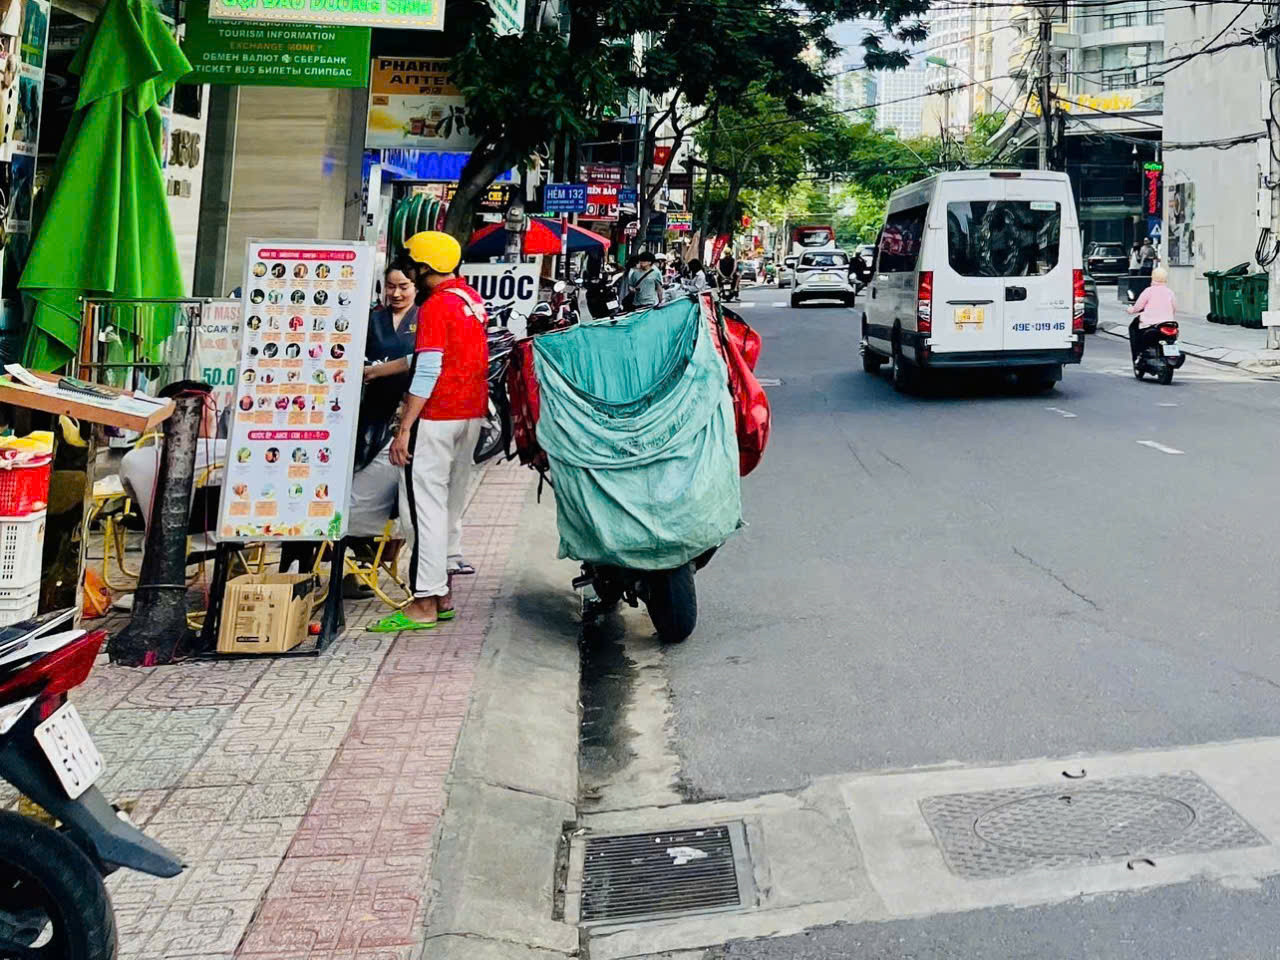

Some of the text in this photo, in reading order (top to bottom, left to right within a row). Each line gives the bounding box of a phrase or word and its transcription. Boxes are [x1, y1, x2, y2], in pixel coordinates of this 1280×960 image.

[218, 29, 335, 40] TOURISM INFORMATION
[229, 42, 323, 52] EXCHANGE MONEY
[202, 53, 347, 64] ОБМЕН ВАЛЮТ СБЕРБАНК
[194, 64, 255, 74] TICKET BUS
[257, 66, 353, 76] БИЛЕТЫ СЛИПБАС
[380, 60, 449, 72] PHARM
[390, 75, 457, 86] АПТЕК
[568, 189, 584, 199] 132
[464, 266, 534, 300] HUỐC
[203, 367, 236, 386] 50.0
